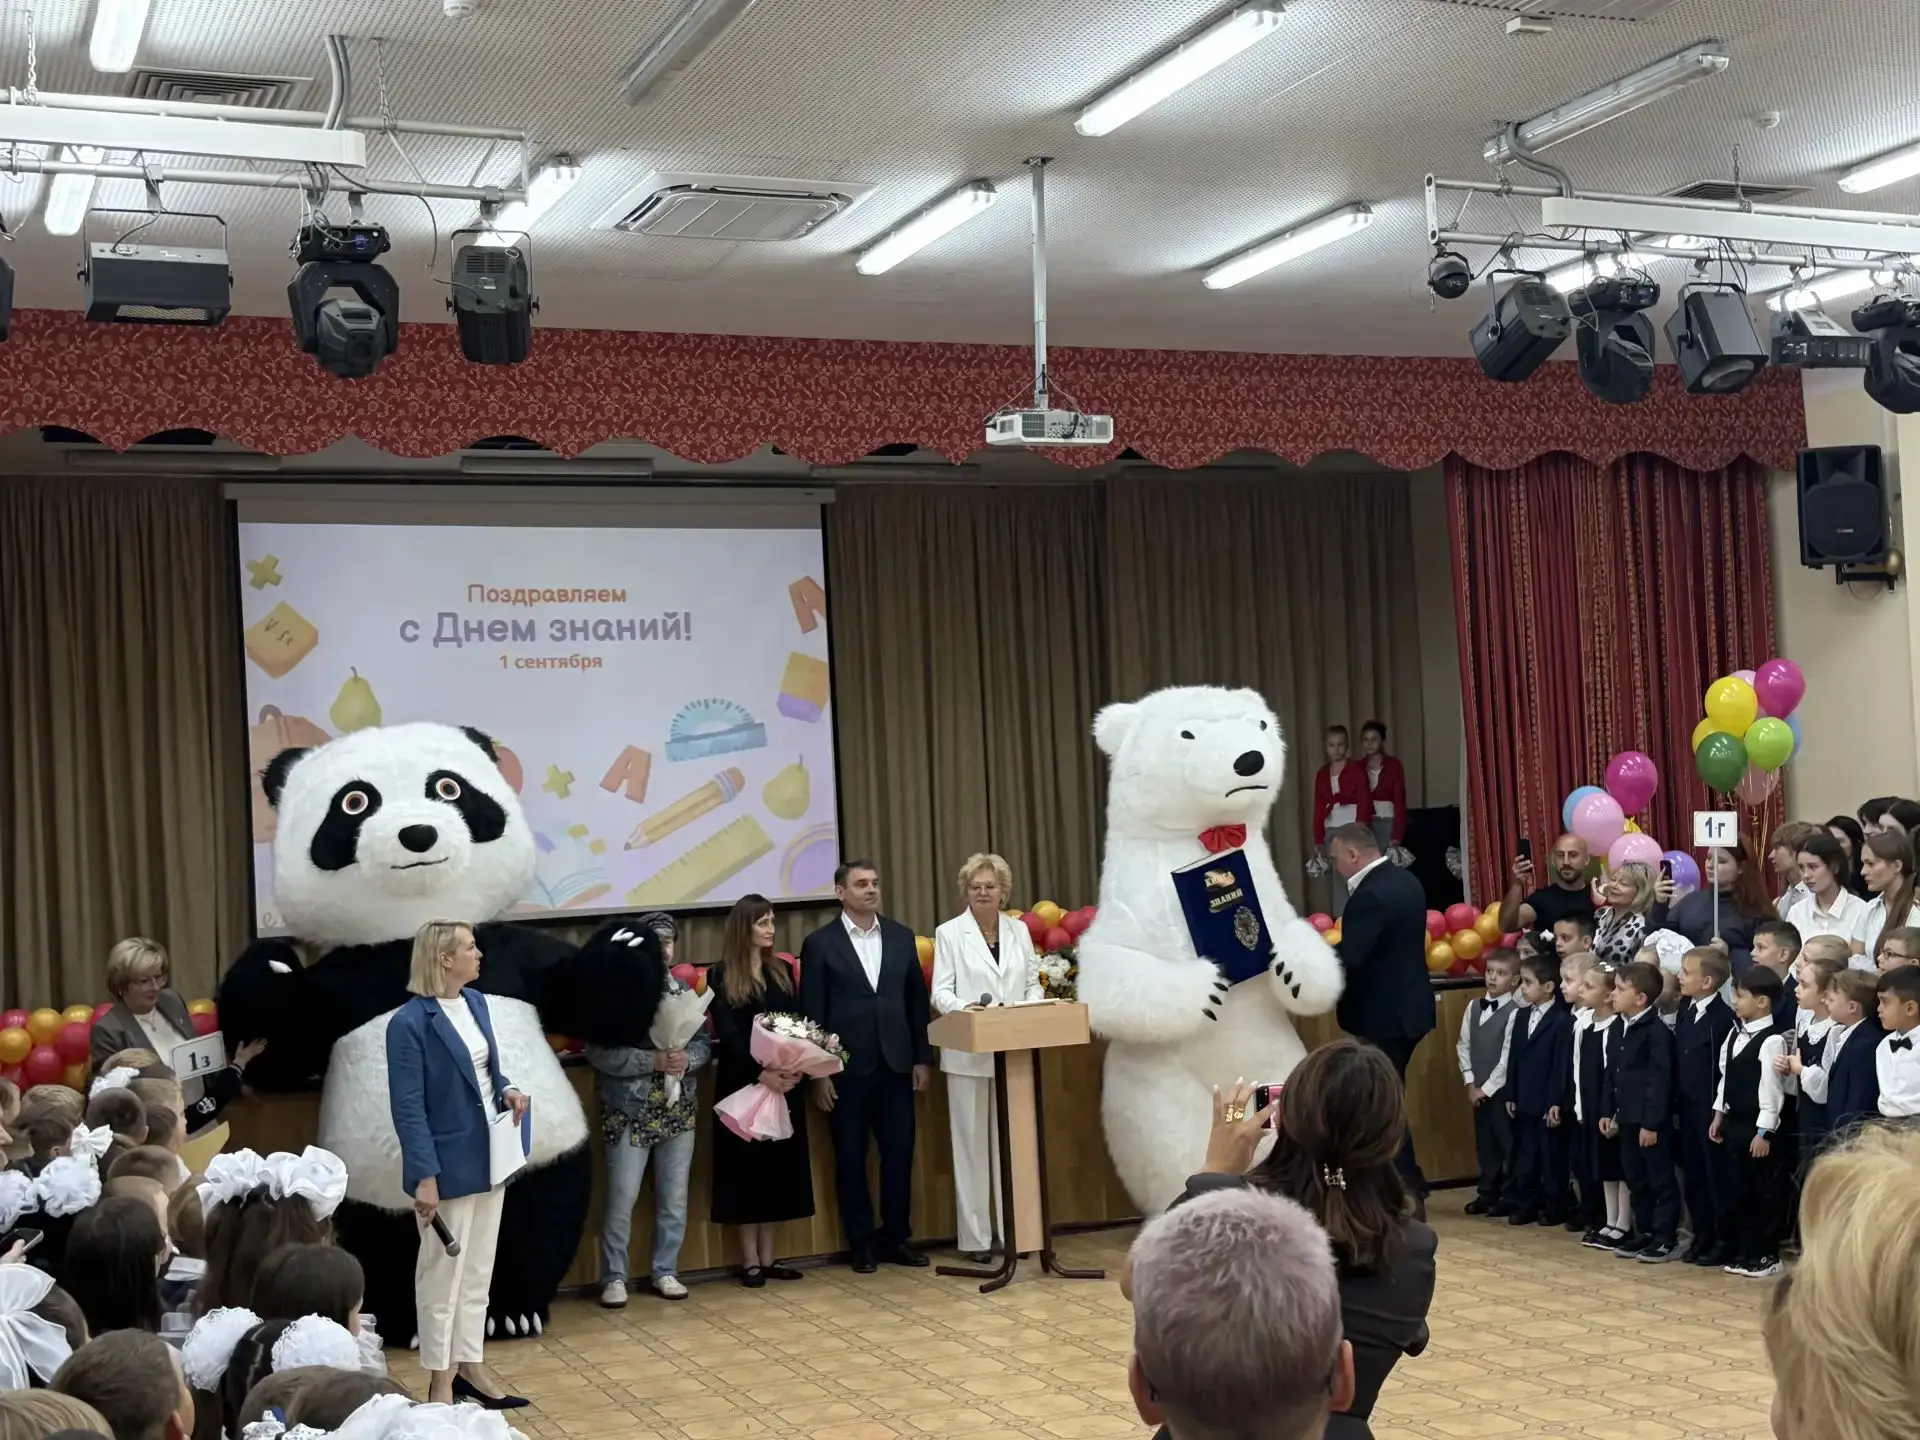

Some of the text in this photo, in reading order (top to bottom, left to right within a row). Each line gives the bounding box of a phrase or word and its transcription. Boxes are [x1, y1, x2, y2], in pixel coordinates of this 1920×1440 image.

[467, 583, 627, 607] Поздравляем
[399, 611, 692, 648] с Днем знаний!
[499, 654, 603, 674] 1 сентября
